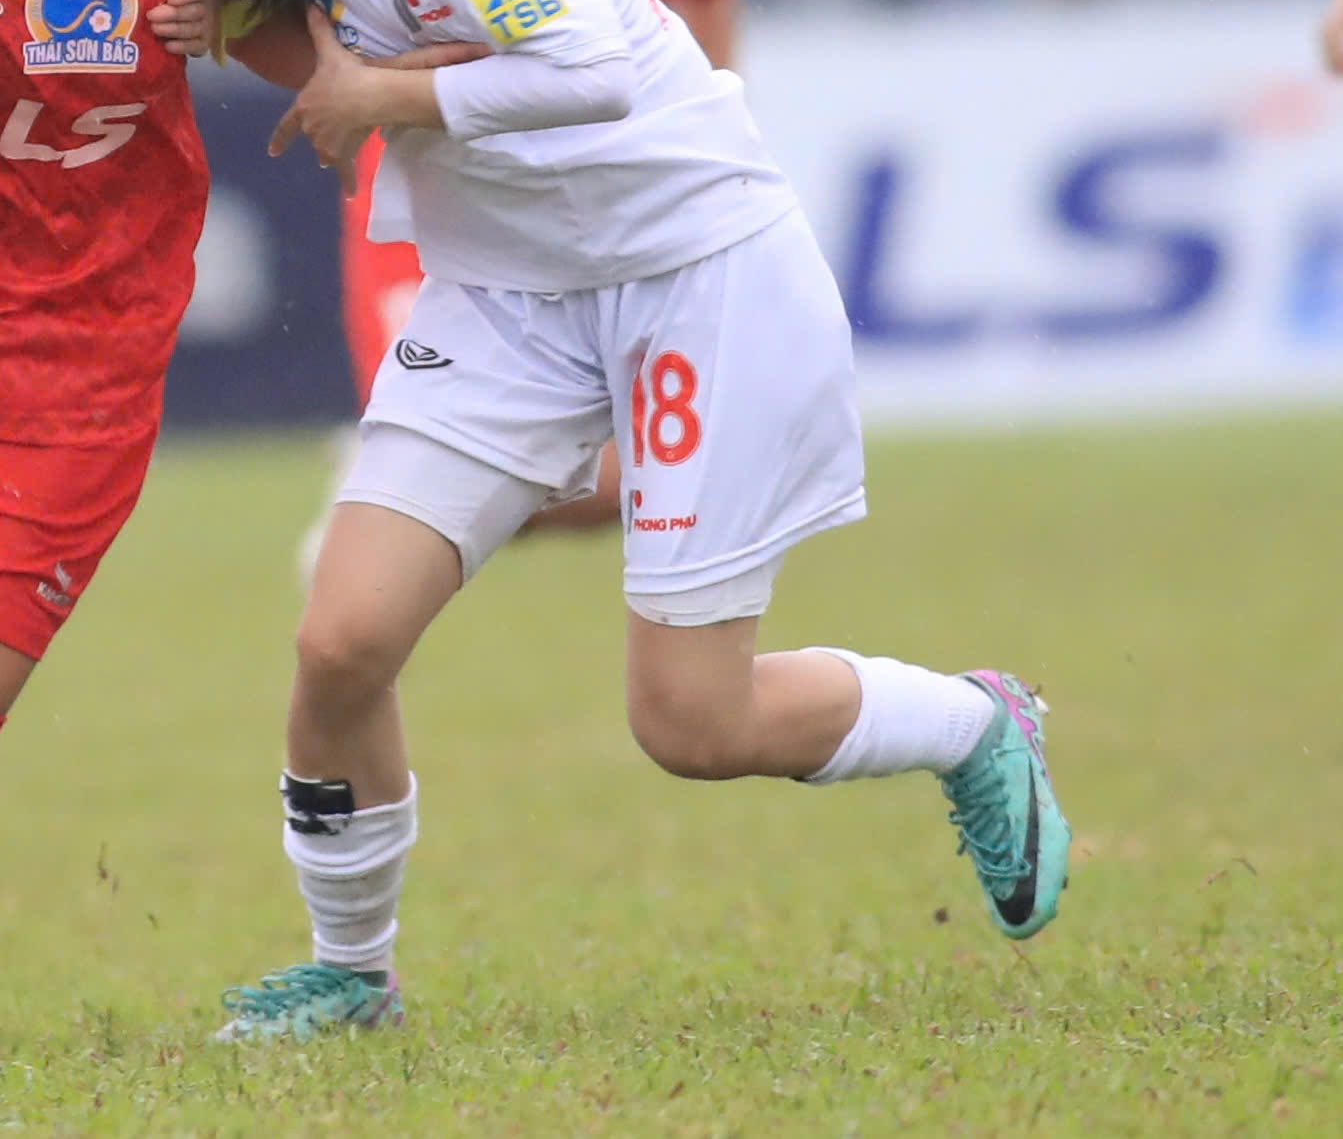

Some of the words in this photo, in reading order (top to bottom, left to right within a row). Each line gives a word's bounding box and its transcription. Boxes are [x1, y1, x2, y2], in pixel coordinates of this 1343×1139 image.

[27, 38, 61, 62] THÁI
[65, 38, 98, 62] SƠN
[846, 126, 1231, 344] LS
[631, 350, 701, 467] 18
